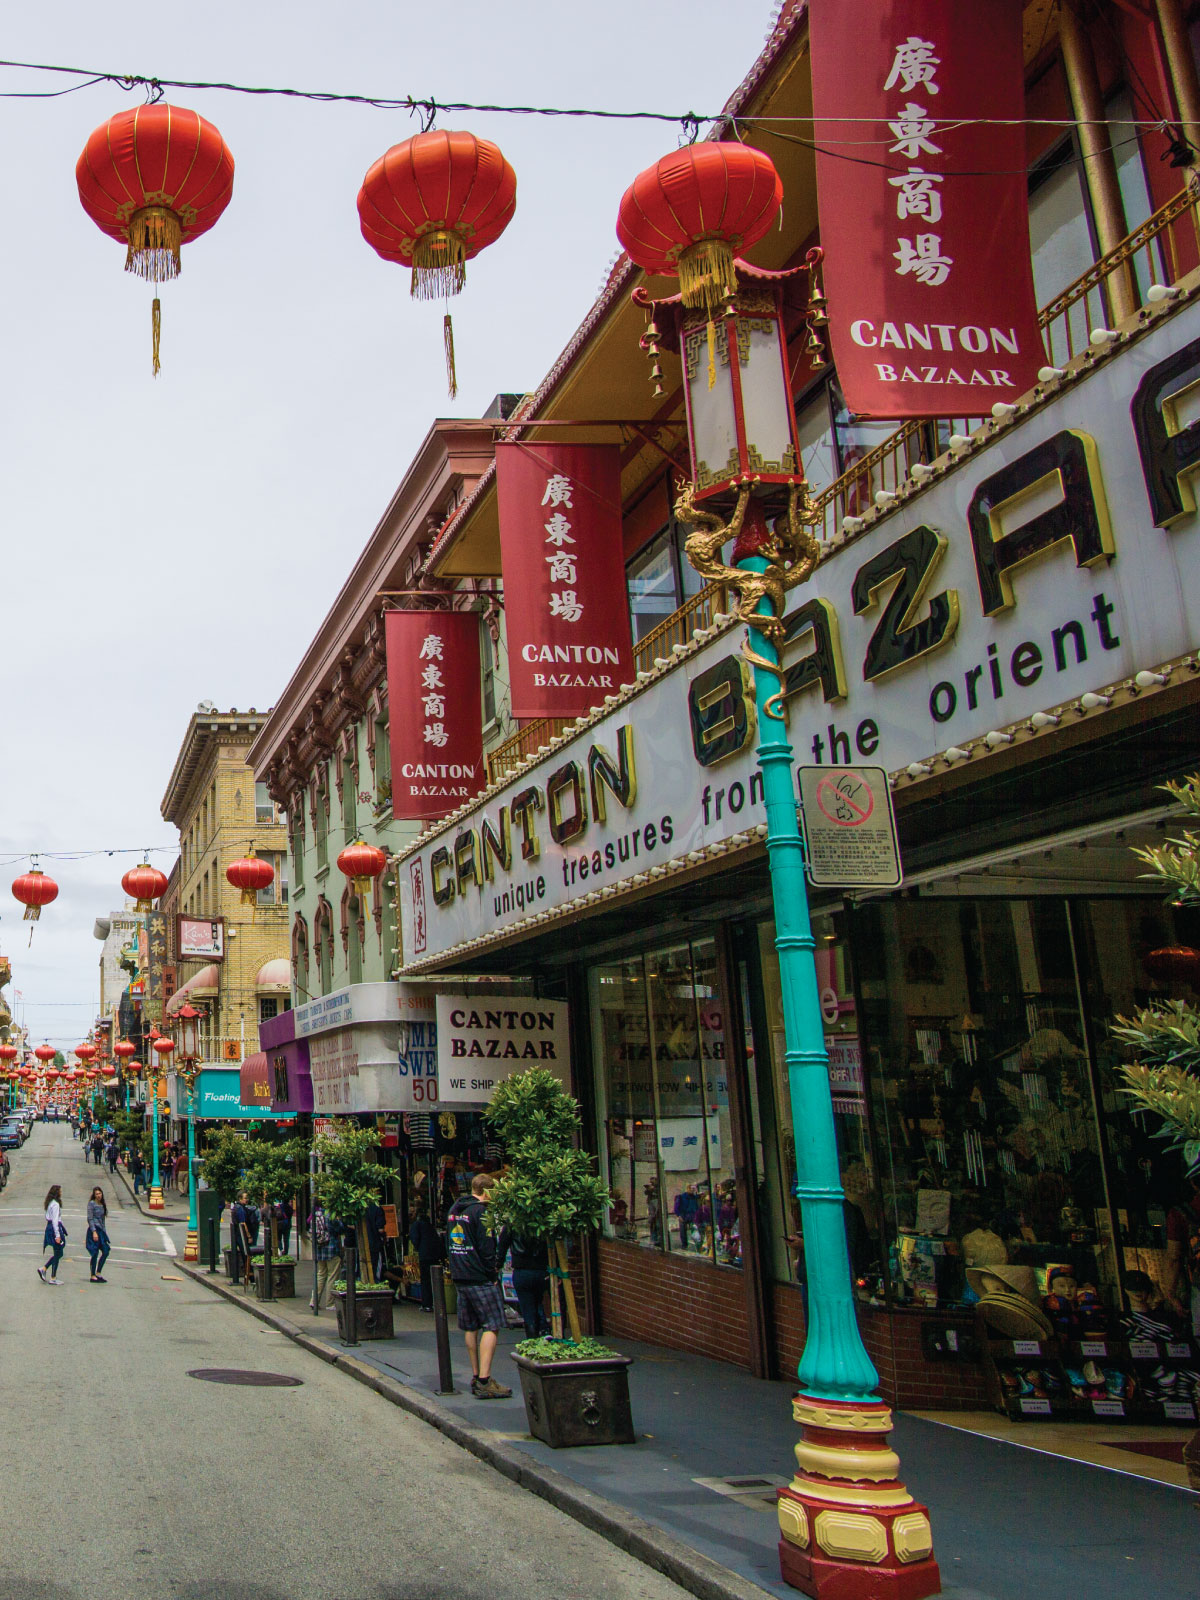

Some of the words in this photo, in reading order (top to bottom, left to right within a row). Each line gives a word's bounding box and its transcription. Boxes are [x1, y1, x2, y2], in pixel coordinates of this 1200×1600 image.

[883, 37, 954, 287] 廣東商場
[850, 318, 1021, 355] CANTON
[875, 363, 1017, 388] BAZAAR
[540, 474, 585, 623] 廣東商場
[521, 643, 620, 666] CANTON
[418, 634, 450, 748] 廣東商場
[533, 672, 614, 688] BAZAAR
[492, 869, 547, 921] unique
[561, 817, 675, 890] treasures
[811, 714, 880, 767] the
[929, 591, 1122, 723] orient
[401, 762, 475, 780] CANTON
[409, 785, 469, 797] BAZAAR
[430, 723, 638, 906] CANTON
[396, 997, 435, 1009] T-SHIR
[450, 1010, 555, 1030] CANTON
[451, 1039, 557, 1059] BAZAAR
[398, 1051, 436, 1076] SWE
[450, 1079, 466, 1089] WE
[471, 1079, 494, 1090] SHIP
[204, 1093, 241, 1104] Floating
